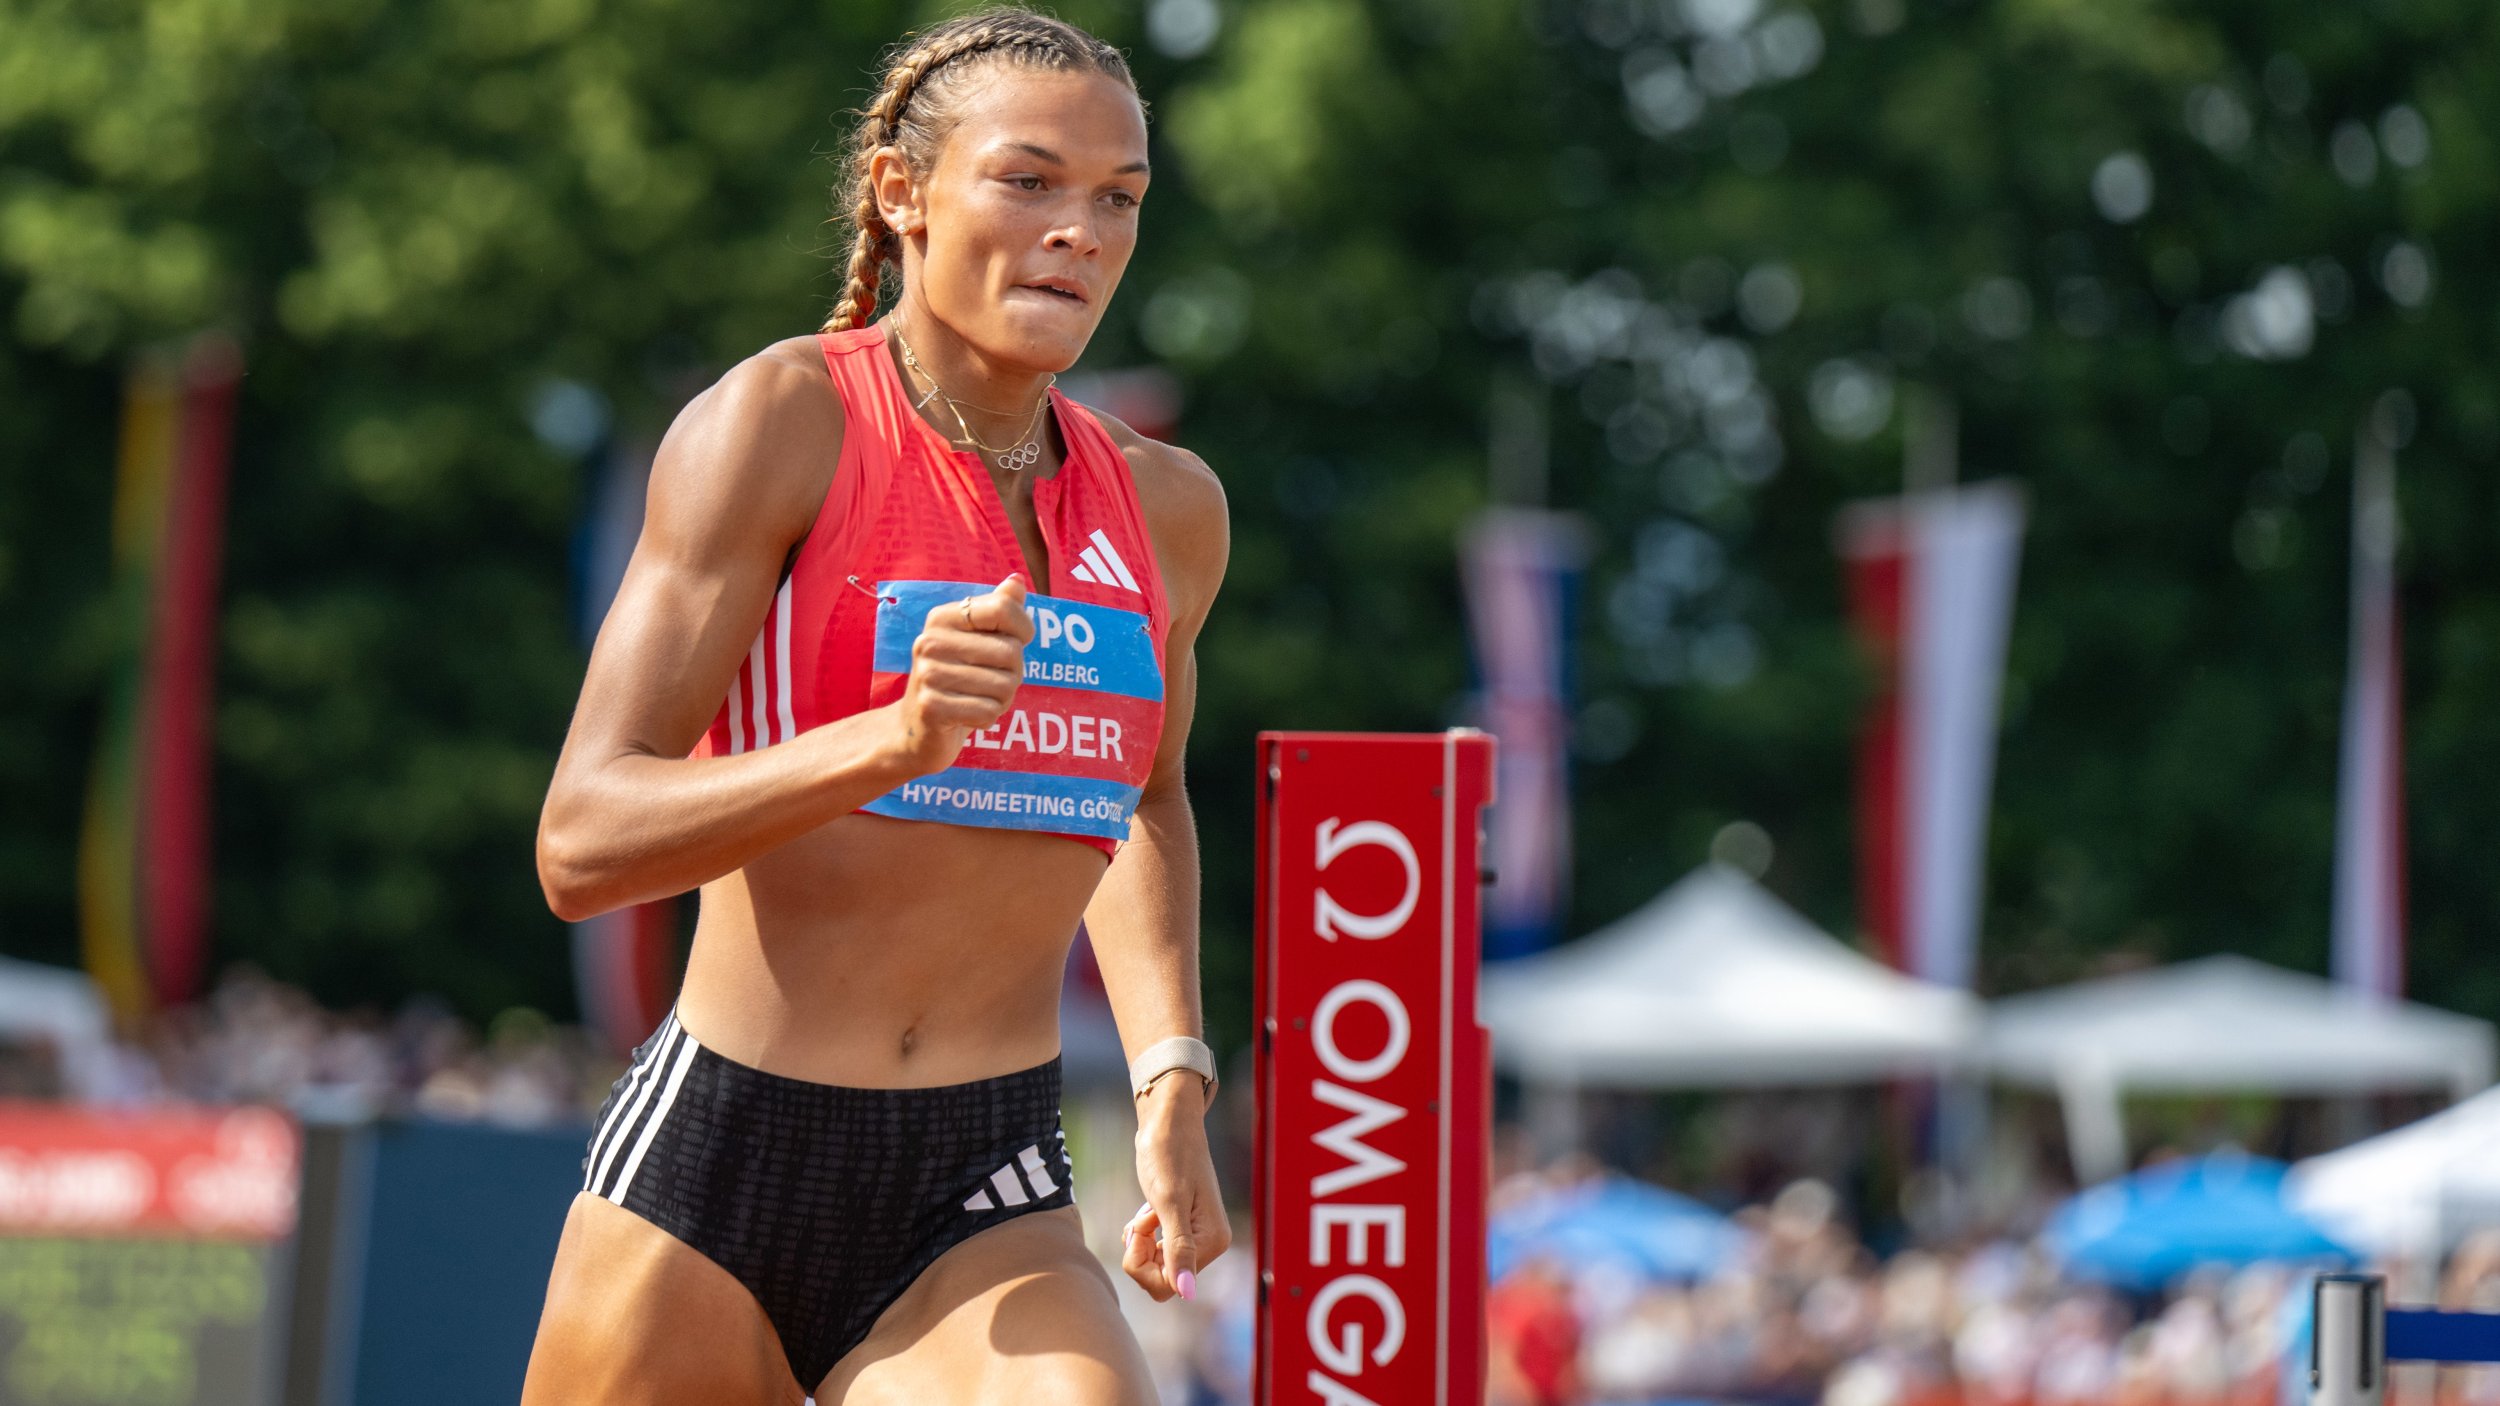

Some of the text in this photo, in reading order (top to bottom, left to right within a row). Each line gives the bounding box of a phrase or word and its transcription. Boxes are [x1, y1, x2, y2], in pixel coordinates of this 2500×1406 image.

[962, 709, 1124, 762] EADER
[902, 783, 1123, 823] HYPOMEETING GÖTZ
